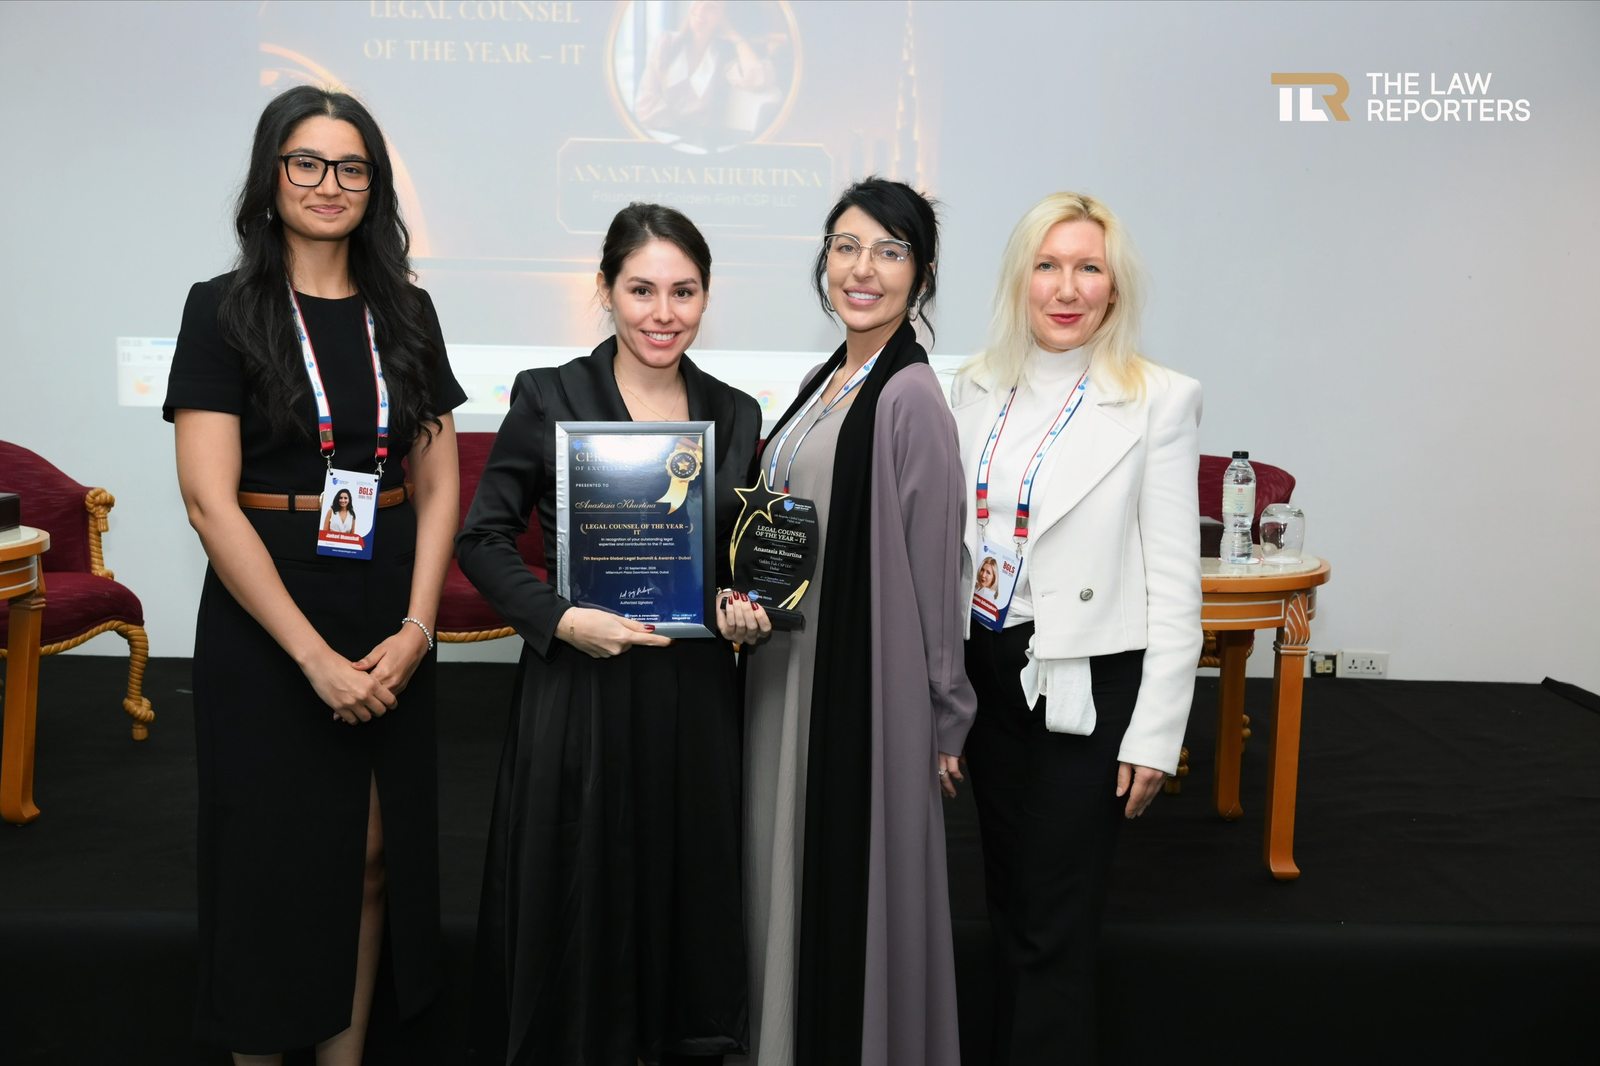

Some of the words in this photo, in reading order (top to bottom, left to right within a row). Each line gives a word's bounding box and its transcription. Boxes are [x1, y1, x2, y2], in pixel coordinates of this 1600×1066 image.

[369, 0, 453, 20] LEGAL
[459, 0, 581, 23] COUNSEL
[363, 38, 400, 60] OF
[404, 39, 457, 62] THE
[463, 40, 534, 64] YEAR
[560, 43, 587, 65] IT
[569, 163, 697, 185] ANASTASIA
[702, 167, 824, 188] KHURTINA
[358, 486, 374, 496] BGLS
[575, 499, 616, 509] Anastasia
[617, 498, 657, 509] Khurtina
[757, 525, 777, 533] LEGAL
[777, 528, 807, 538] COUNSEL
[778, 534, 794, 542] YEAR
[753, 546, 778, 555] Anastasia
[778, 549, 802, 559] Khurtina
